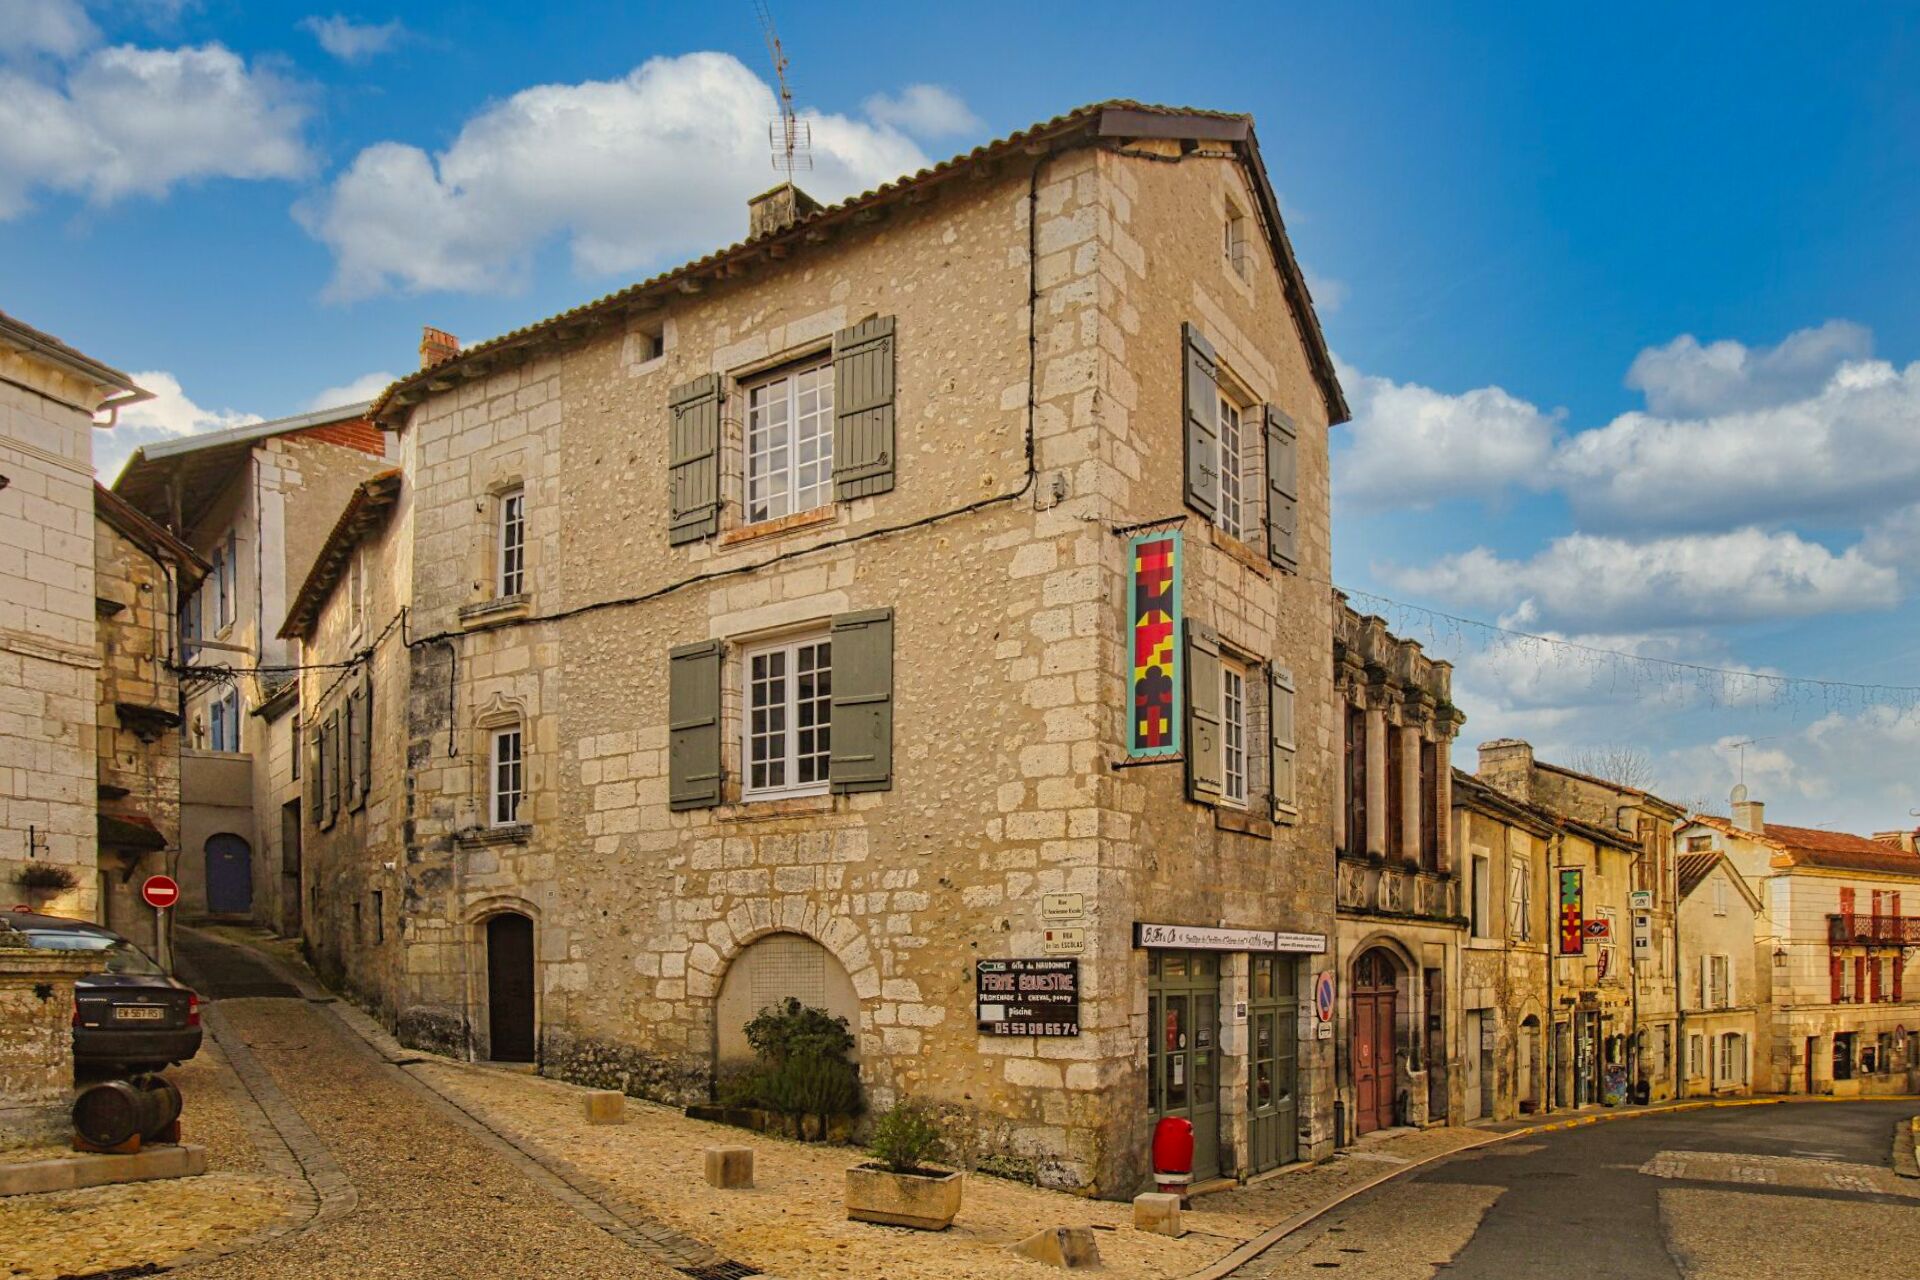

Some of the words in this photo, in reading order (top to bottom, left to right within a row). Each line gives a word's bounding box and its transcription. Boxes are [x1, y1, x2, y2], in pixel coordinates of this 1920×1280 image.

[982, 973, 1015, 990] FERME
[979, 993, 1015, 1001] PROMENADE
[1052, 995, 1072, 1003] poney
[1009, 1007, 1032, 1017] piscine
[1011, 1022, 1026, 1034] 53
[1063, 1023, 1078, 1035] 74
